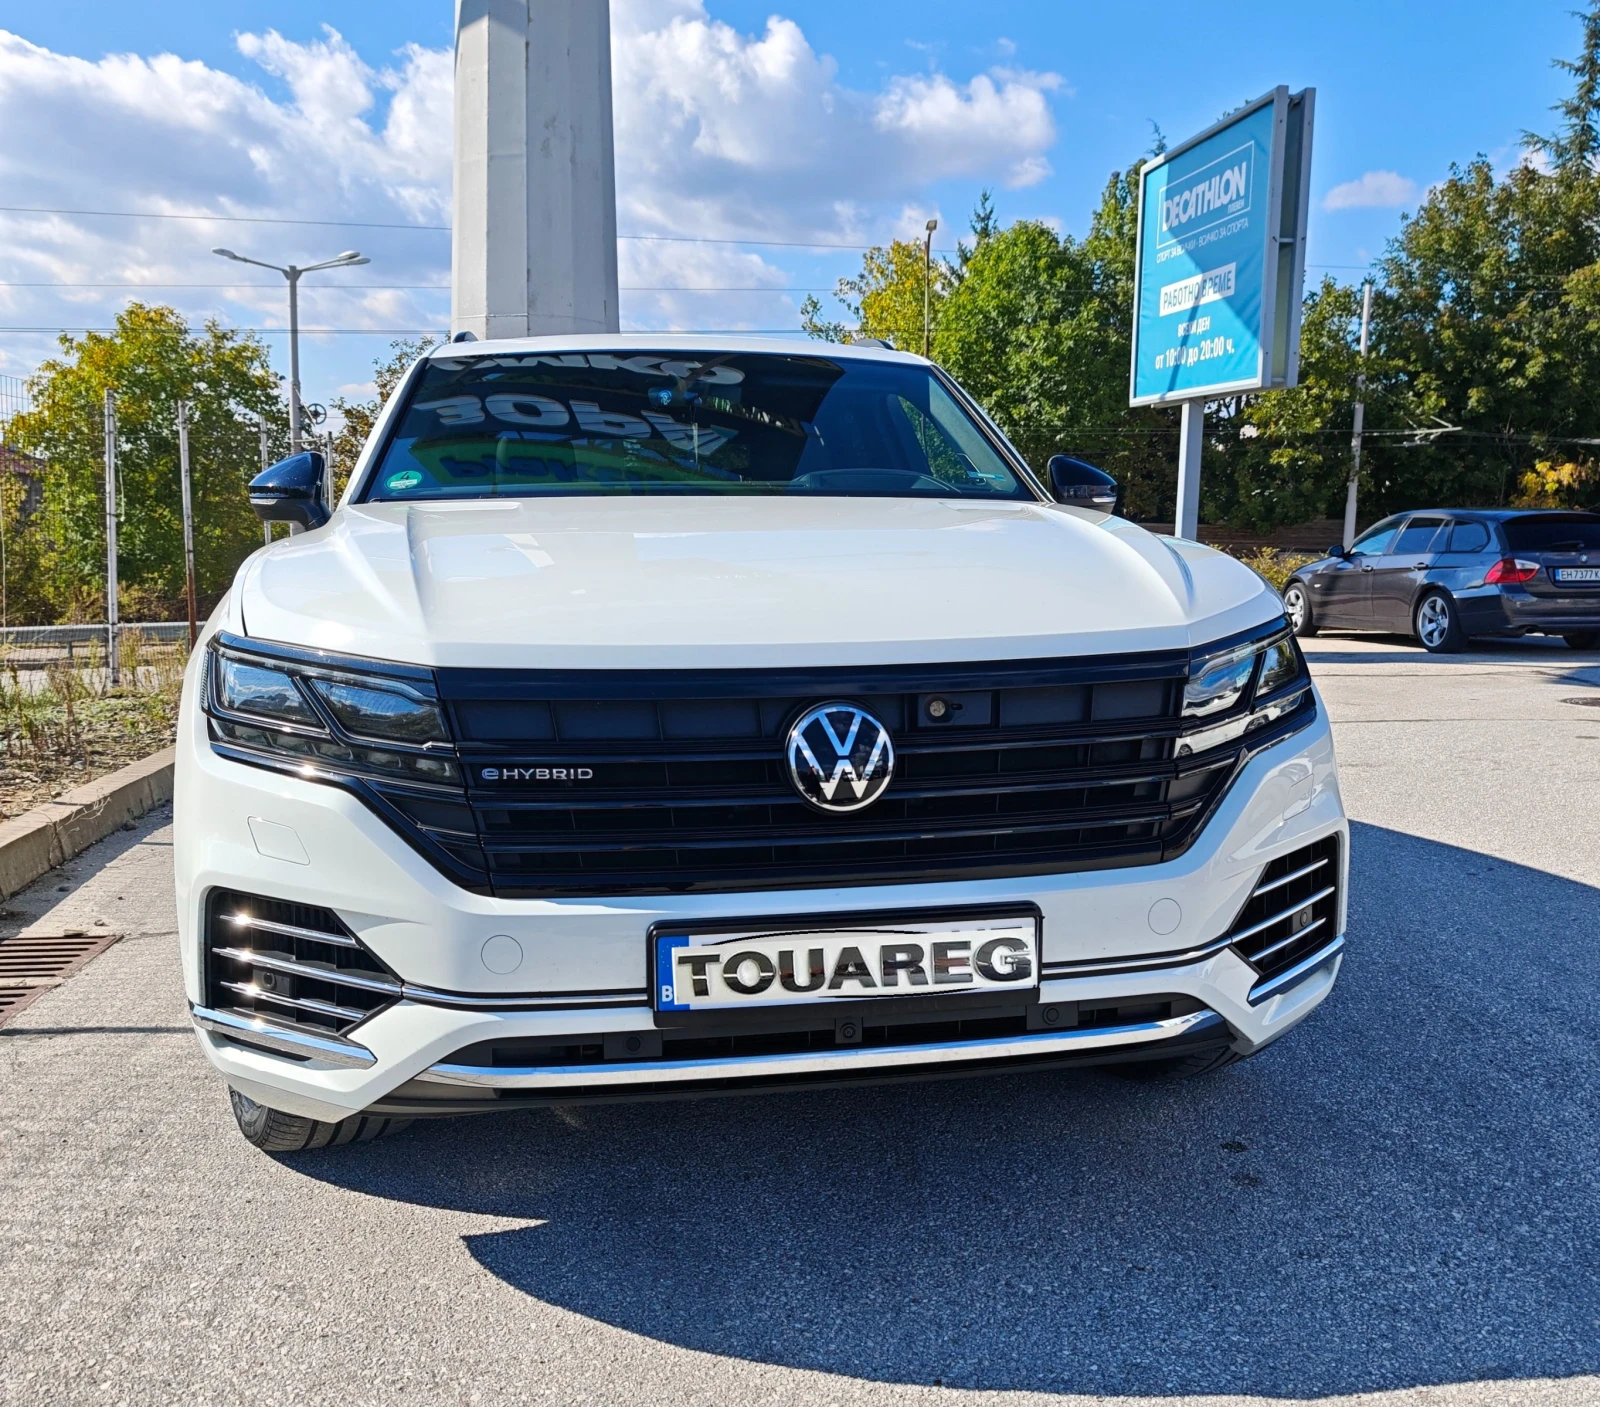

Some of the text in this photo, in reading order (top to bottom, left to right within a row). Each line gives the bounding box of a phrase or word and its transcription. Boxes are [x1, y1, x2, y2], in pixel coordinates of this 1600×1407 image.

[1163, 162, 1246, 231] DECATHLON
[1219, 226, 1227, 239] ЗА
[1163, 270, 1232, 310] РАБОТНО ВРЕМЕ
[1197, 316, 1211, 335] ДЕН
[1155, 335, 1235, 370] от 10:00 до 20:00 ч.
